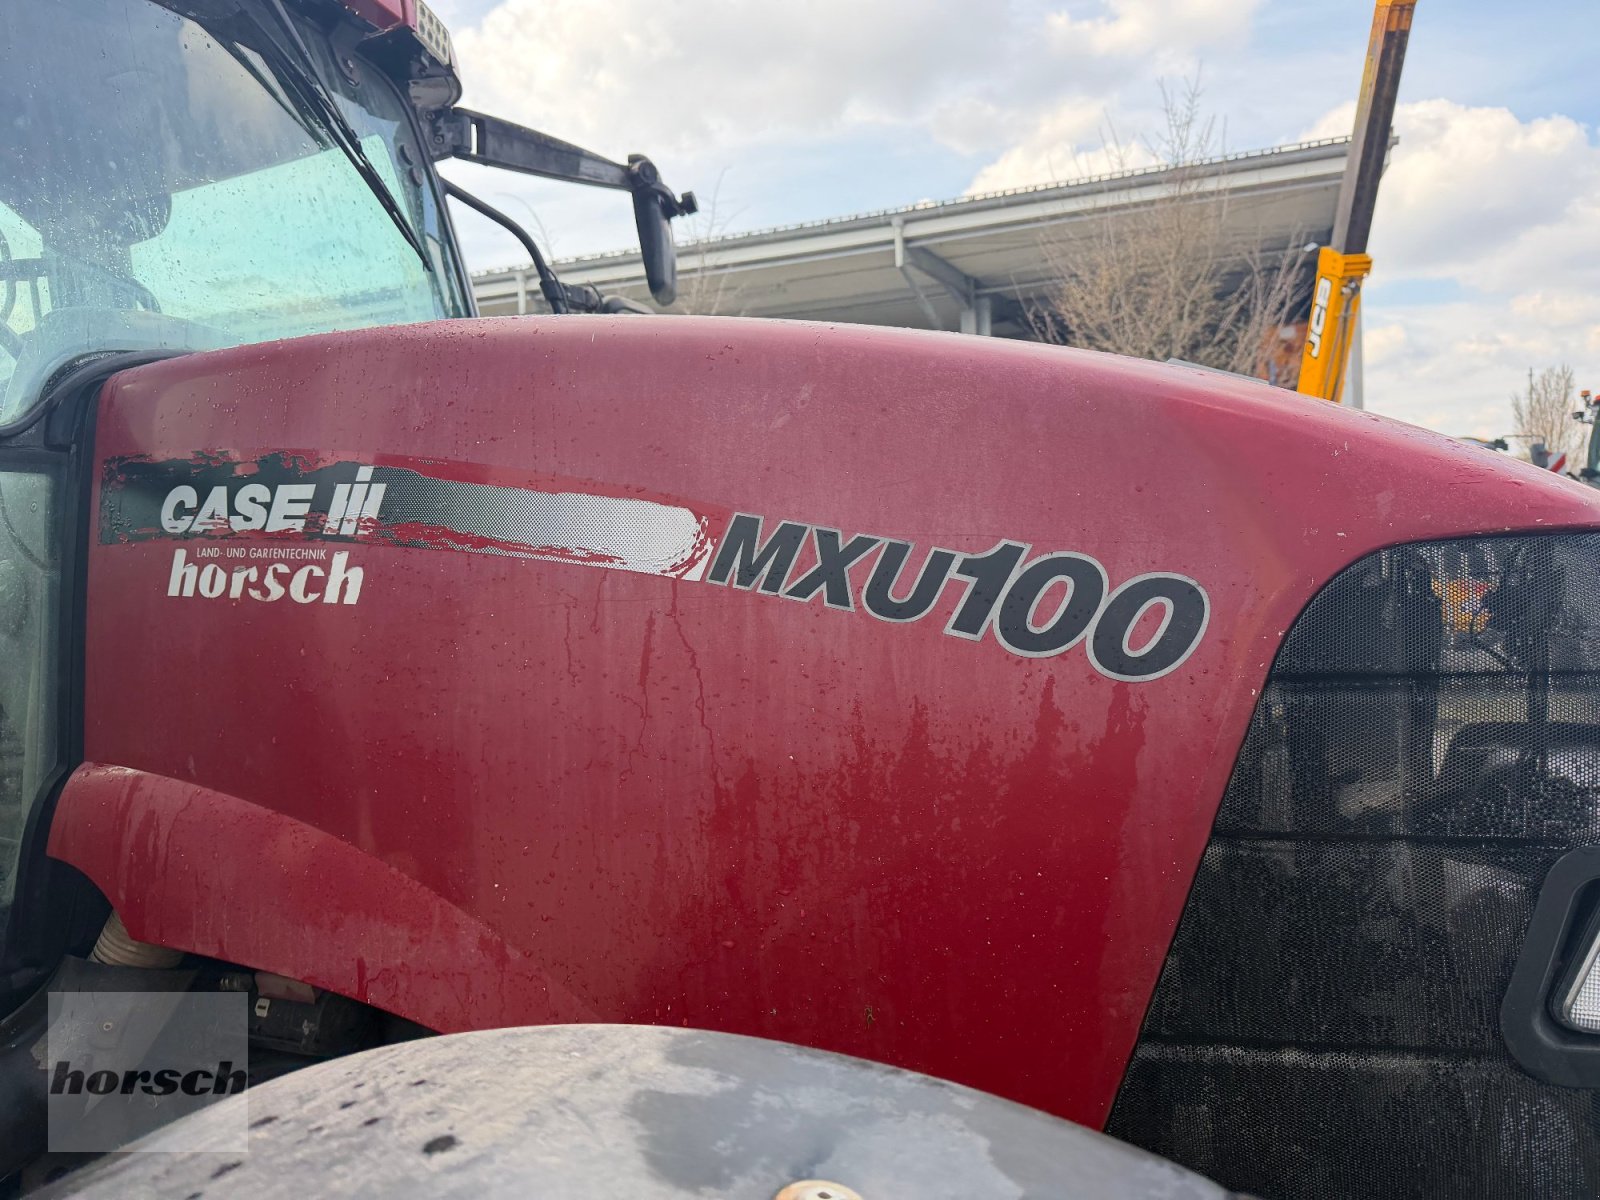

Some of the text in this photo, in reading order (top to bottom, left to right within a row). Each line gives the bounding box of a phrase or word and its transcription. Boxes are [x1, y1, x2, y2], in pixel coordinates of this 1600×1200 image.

[1306, 277, 1332, 359] JCB
[160, 483, 316, 533] CASE
[167, 548, 364, 605] horsch
[226, 547, 246, 559] UND
[249, 547, 327, 560] GARTENTECHNIK
[705, 511, 1210, 682] MXU100
